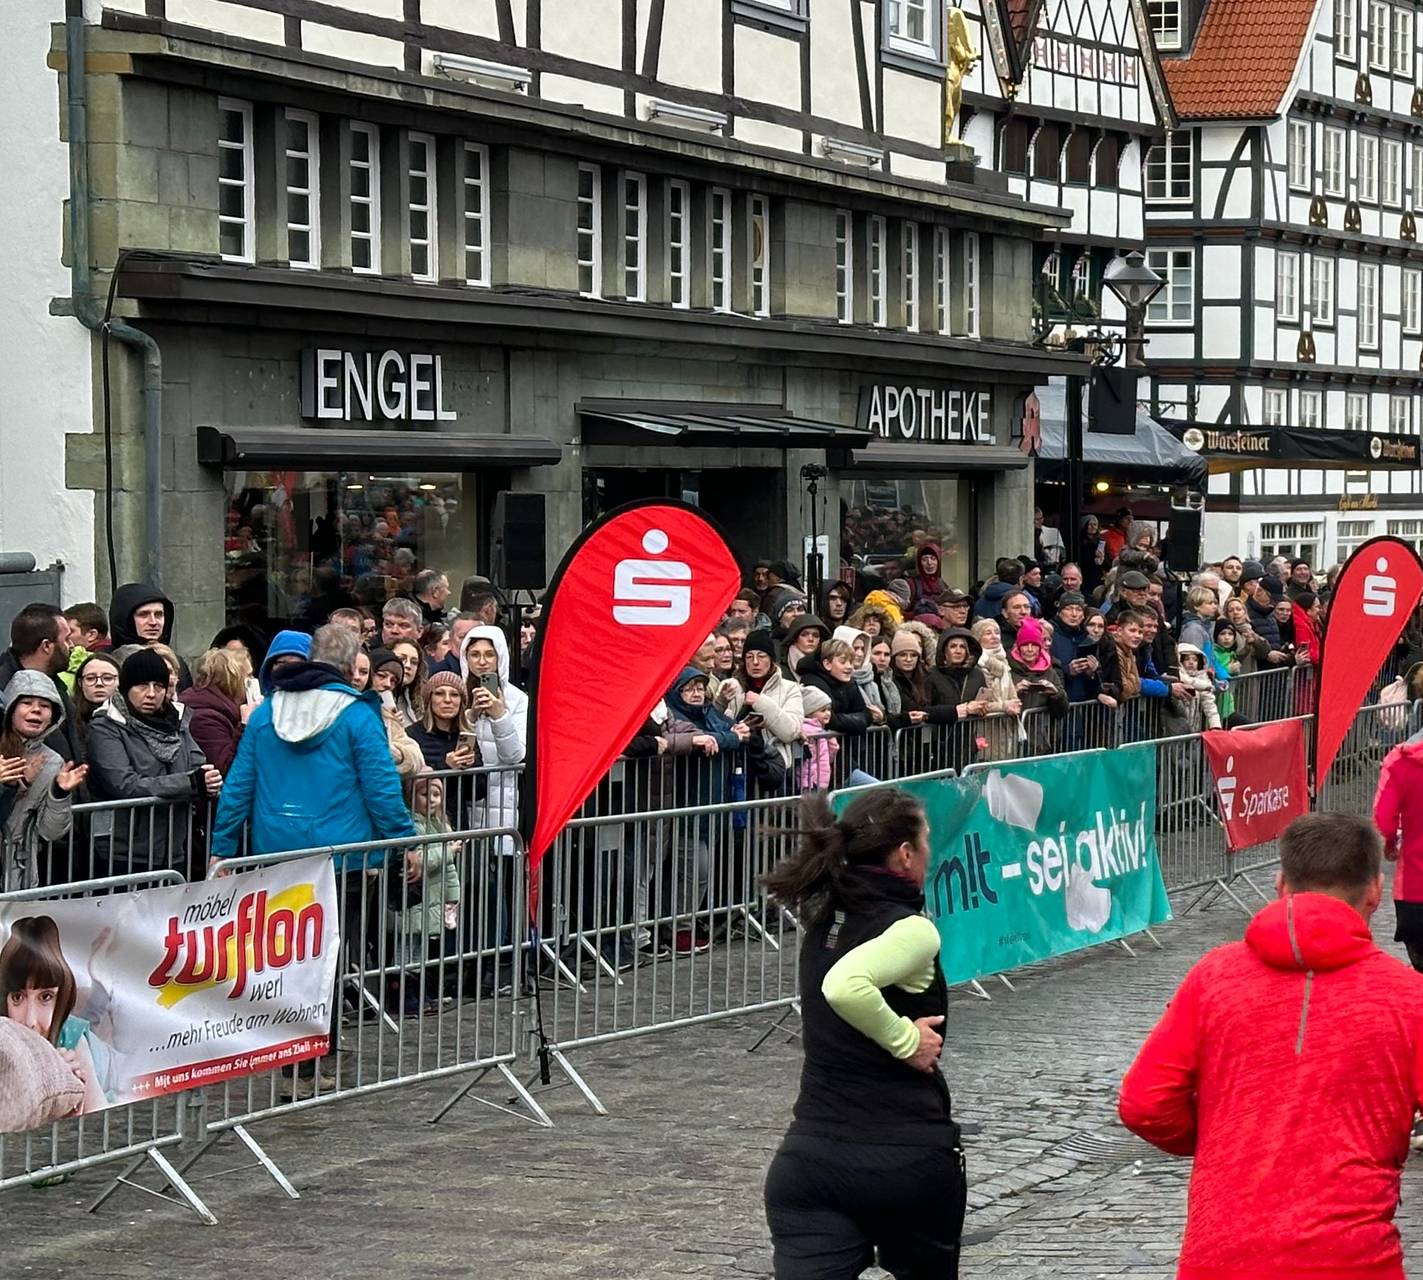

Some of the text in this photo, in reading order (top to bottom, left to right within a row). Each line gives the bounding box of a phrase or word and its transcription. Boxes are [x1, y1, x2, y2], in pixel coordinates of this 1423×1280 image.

[317, 349, 457, 421] ENGEL
[868, 384, 991, 441] APOTHEKE
[1206, 429, 1271, 453] Warsteiner
[1026, 820, 1071, 896] sei
[1076, 801, 1147, 882] aktiv!
[183, 888, 237, 925] möbel
[148, 890, 323, 999] turflon
[250, 972, 284, 1002] werl
[206, 1013, 243, 1039] Freude
[246, 1013, 269, 1030] am
[154, 1074, 172, 1089] Mit
[172, 1071, 190, 1083] uns
[191, 1062, 232, 1079] kommen
[233, 1058, 249, 1070] Sie
[278, 1048, 292, 1060] ans
